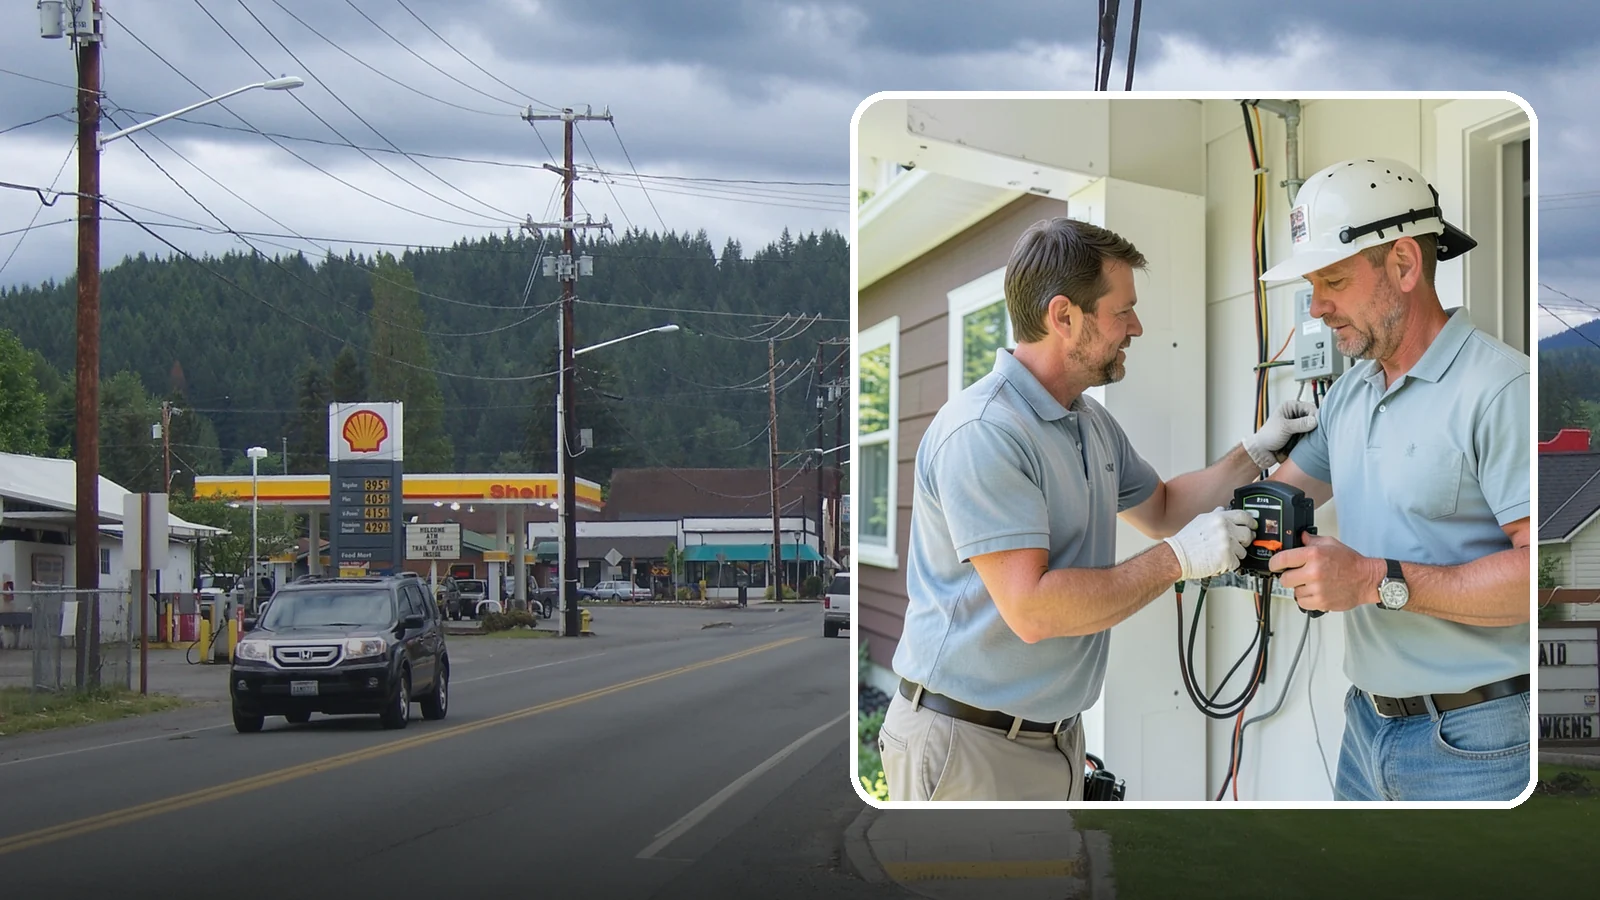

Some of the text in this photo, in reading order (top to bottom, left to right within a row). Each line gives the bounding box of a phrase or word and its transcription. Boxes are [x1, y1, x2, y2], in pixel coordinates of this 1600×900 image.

[366, 480, 383, 490] 395
[490, 484, 547, 498] Shell
[366, 494, 383, 504] 405
[366, 508, 383, 518] 415
[366, 522, 383, 532] 429
[1539, 643, 1566, 666] AID
[1539, 716, 1591, 738] WKENS
